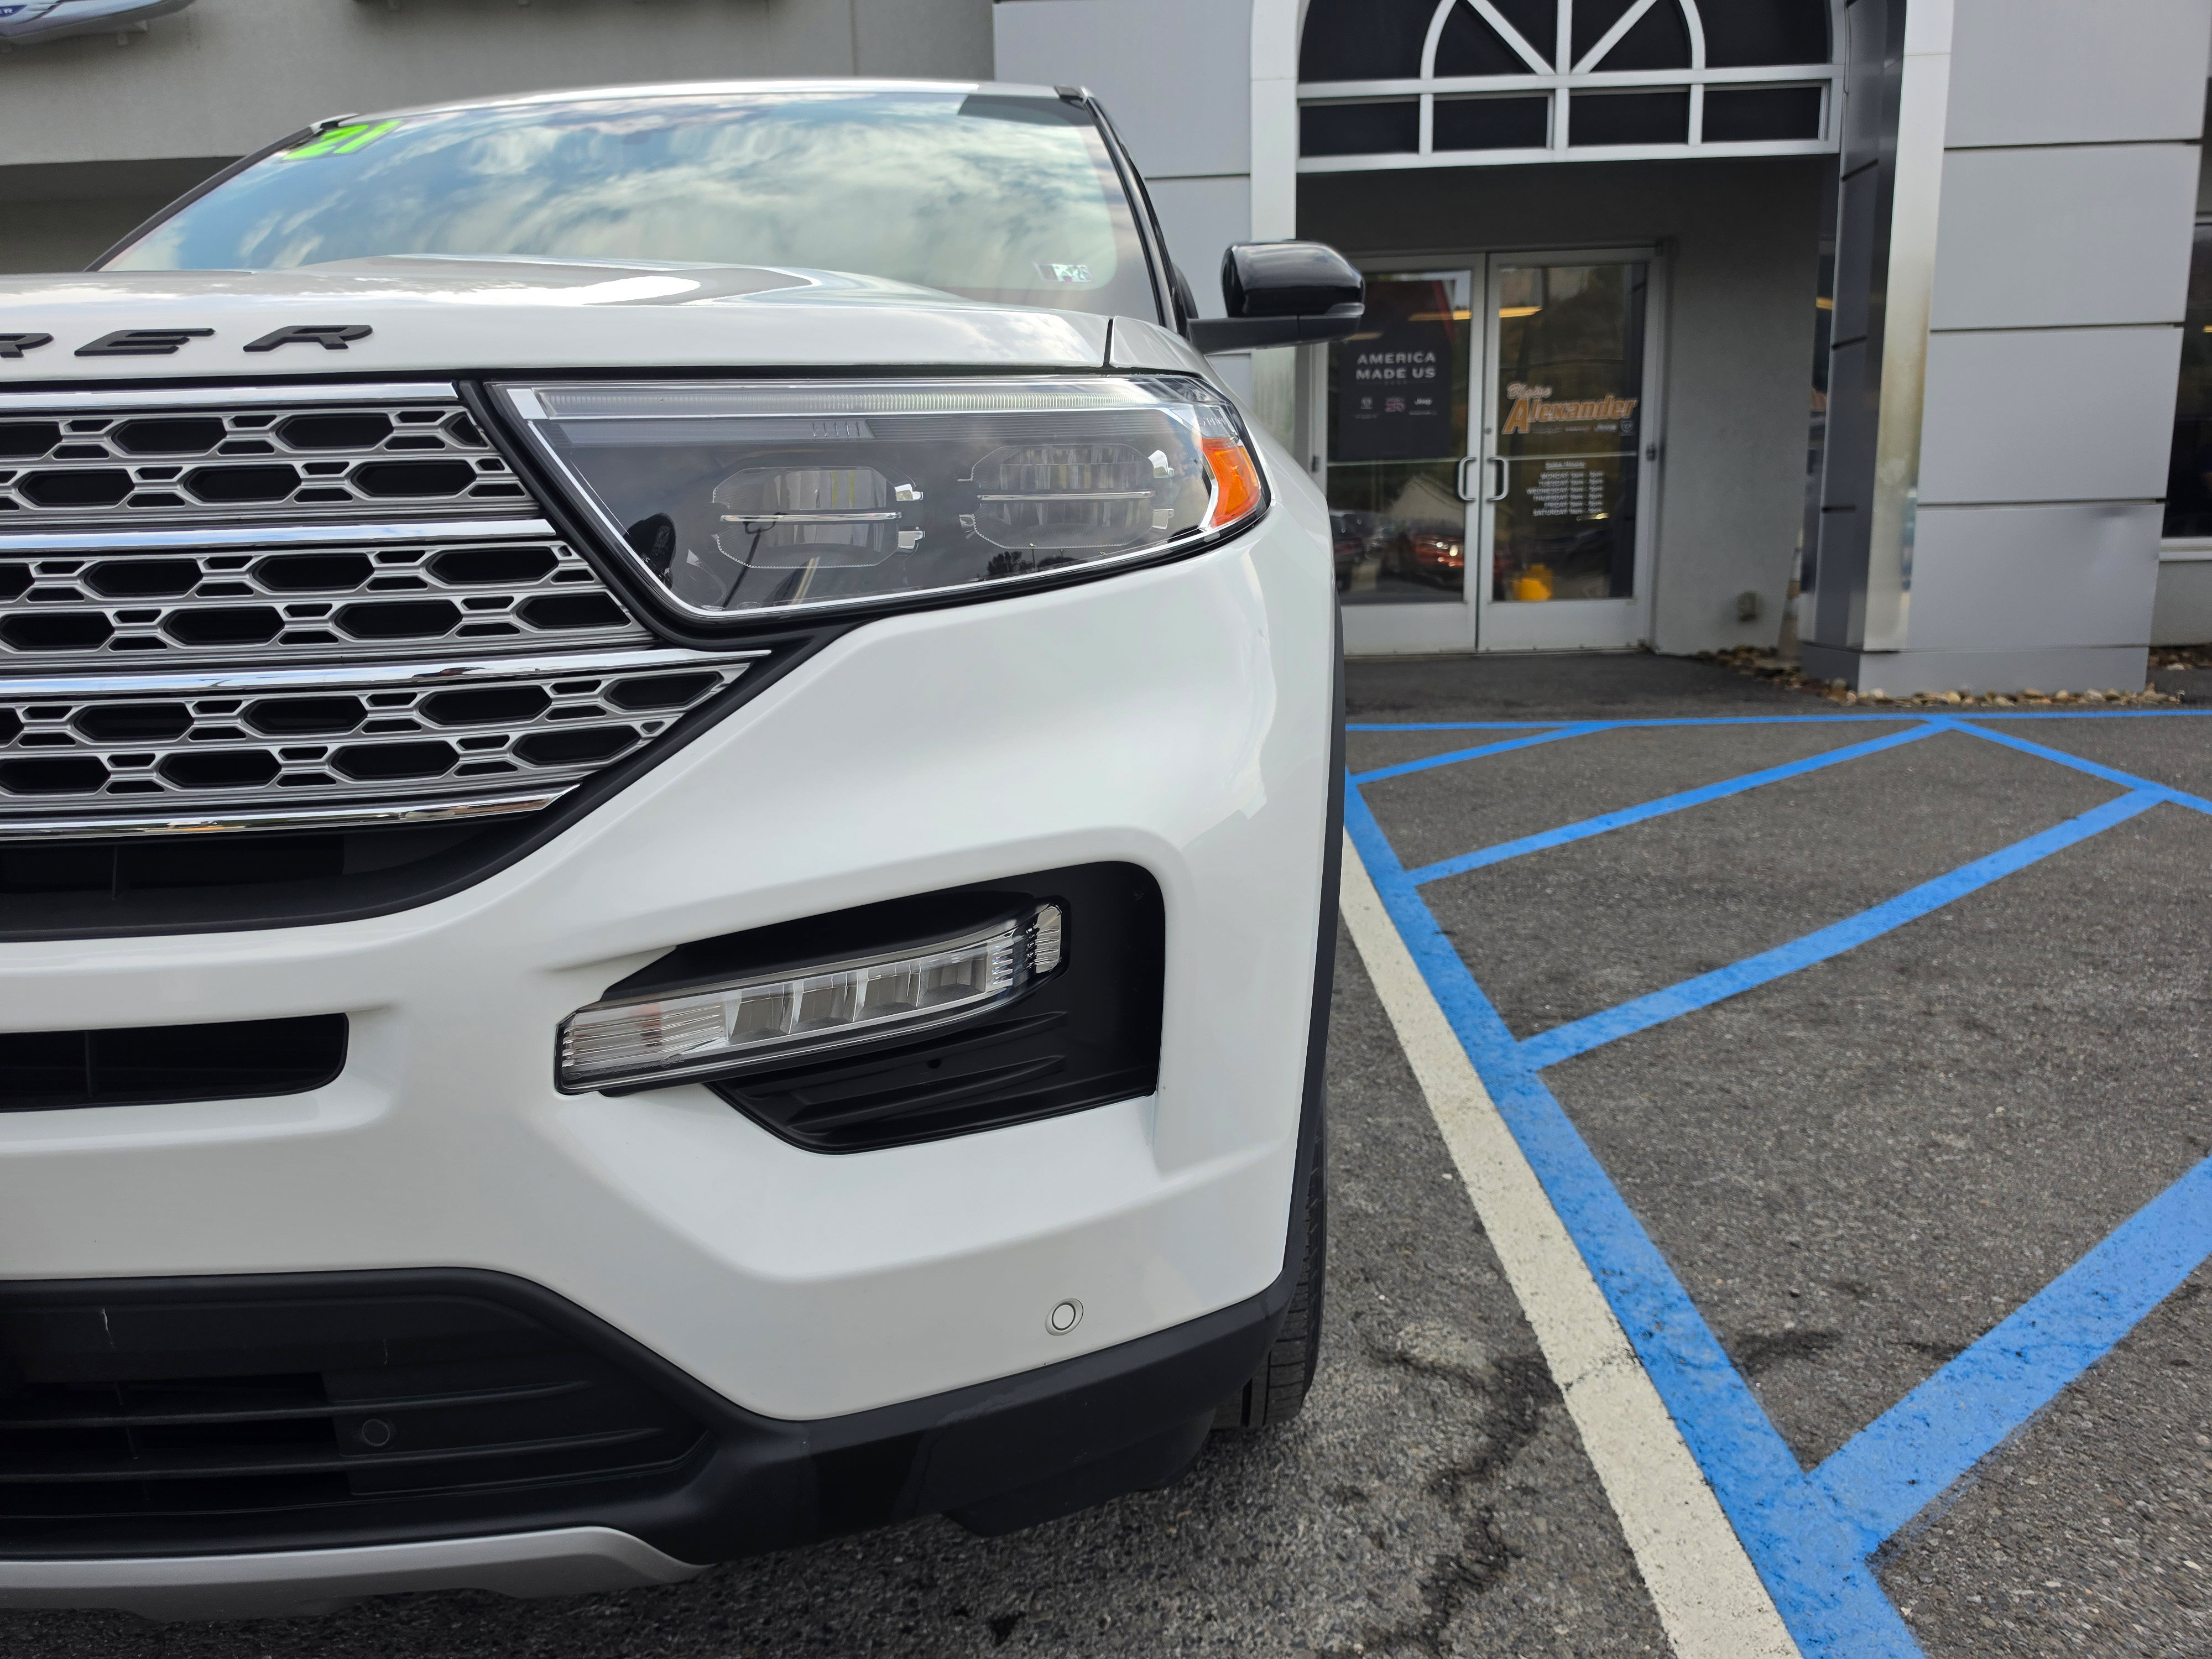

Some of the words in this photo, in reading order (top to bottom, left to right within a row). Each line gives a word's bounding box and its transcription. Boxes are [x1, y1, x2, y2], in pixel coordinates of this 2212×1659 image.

[282, 120, 403, 161] 21
[1357, 352, 1436, 365] AMERICA
[1355, 367, 1407, 380] MADE
[1412, 367, 1436, 379] US
[1502, 395, 1638, 435] Alexander
